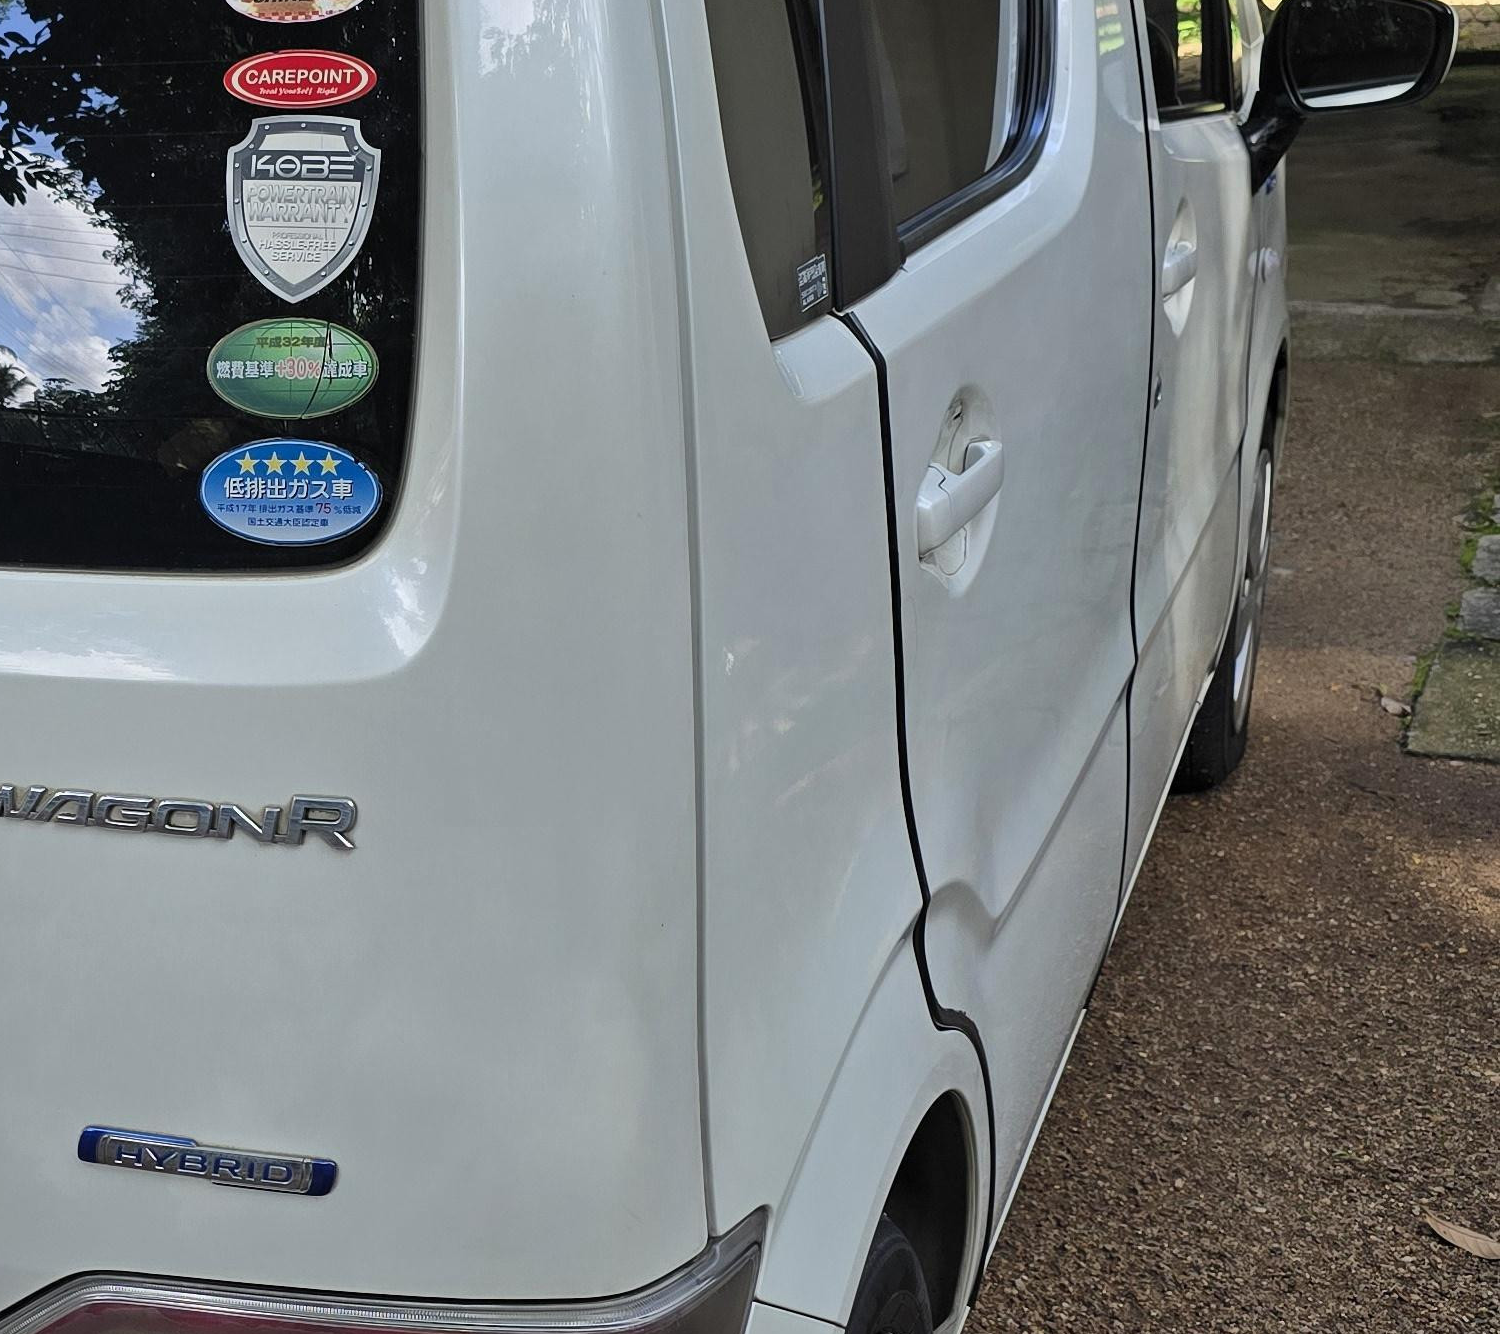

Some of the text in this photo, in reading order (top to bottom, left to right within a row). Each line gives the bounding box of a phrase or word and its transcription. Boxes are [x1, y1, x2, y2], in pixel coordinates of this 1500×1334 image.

[245, 69, 356, 85] CAREPOINT
[251, 154, 356, 180] KOBE
[246, 183, 357, 205] POWERTRAIN
[247, 202, 354, 223] WARRANTY
[259, 239, 337, 252] HASSLE-FREE
[271, 252, 323, 263] SERVICE
[223, 477, 354, 500] 低排出ガス車
[114, 1144, 295, 1185] HYBRID
